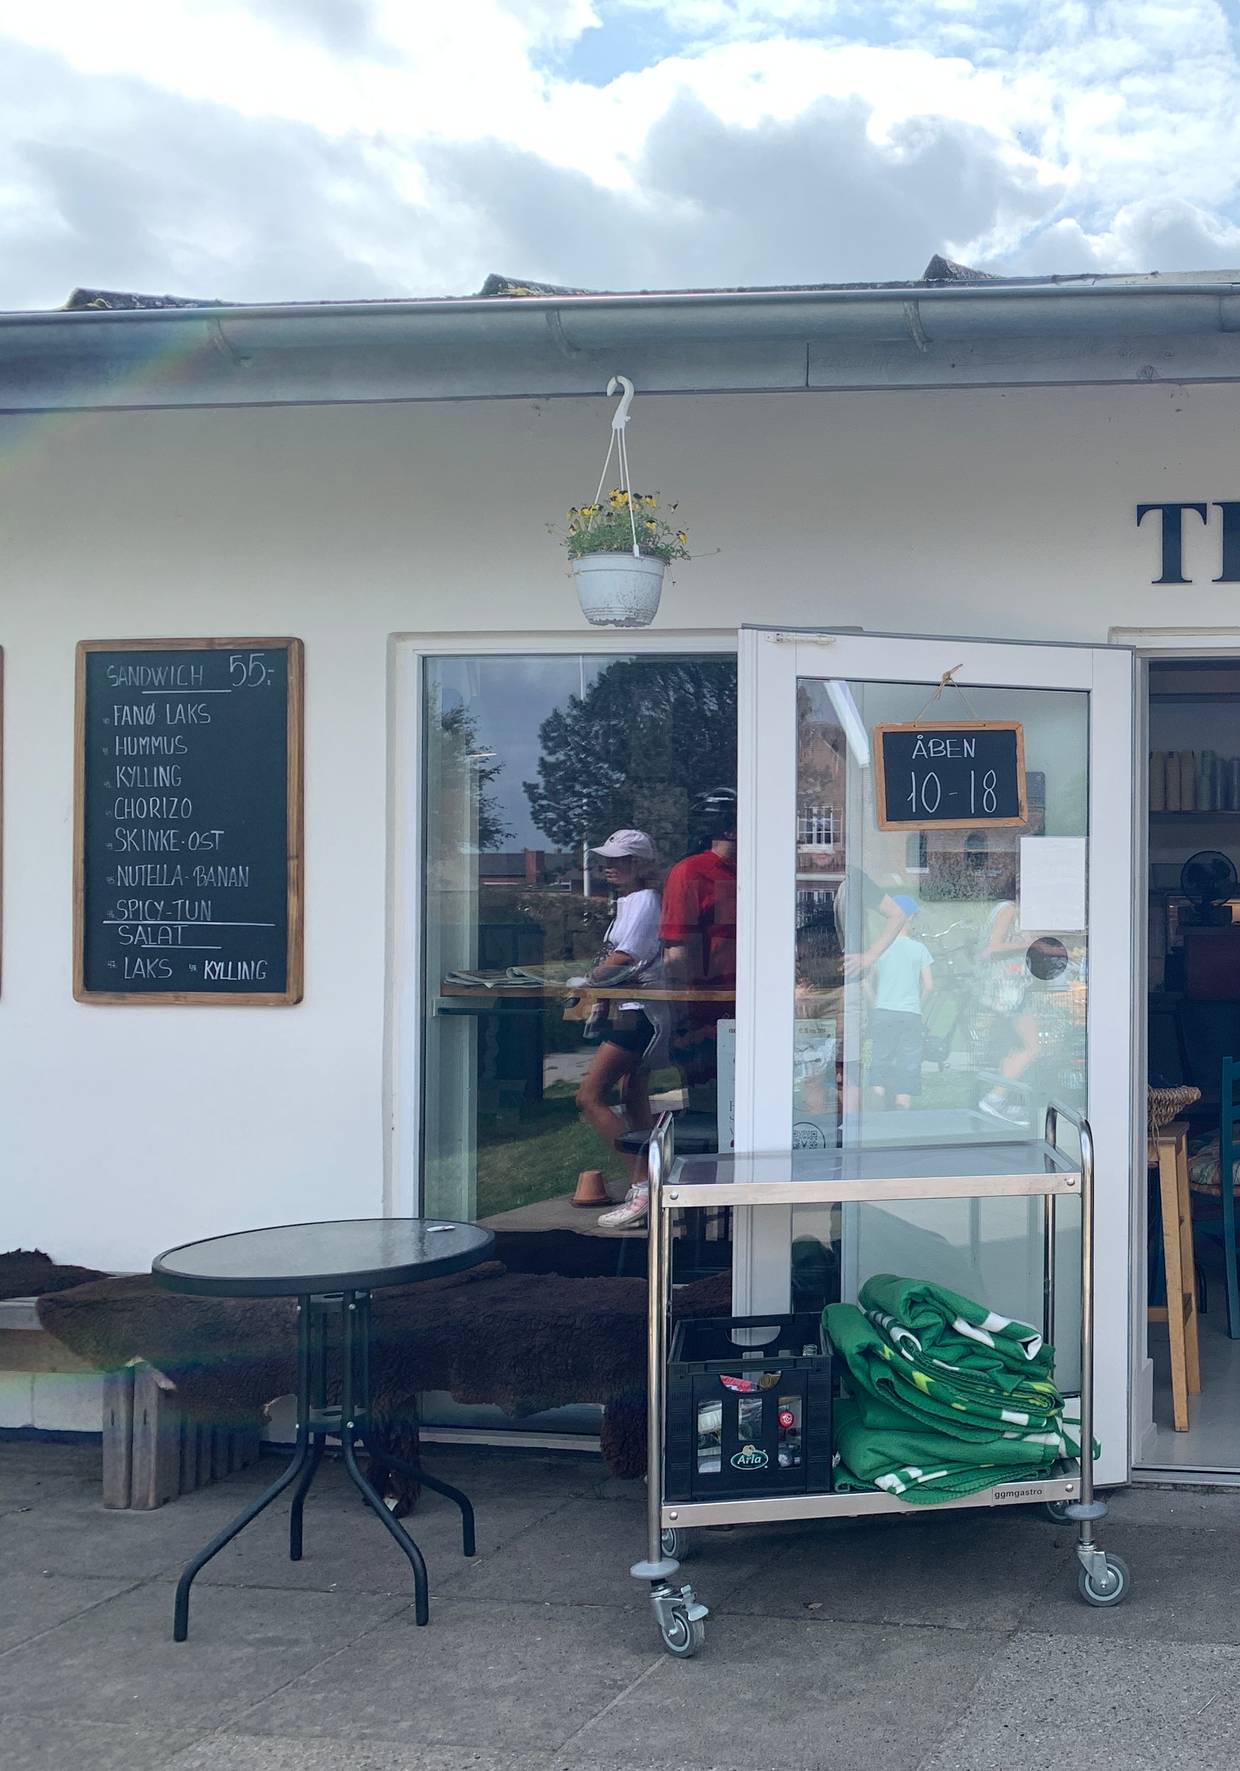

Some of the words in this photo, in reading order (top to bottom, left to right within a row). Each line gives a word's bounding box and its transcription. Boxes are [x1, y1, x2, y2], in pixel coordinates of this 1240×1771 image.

[106, 664, 204, 687] SANDWICH
[114, 702, 156, 726] FANØ
[166, 703, 212, 725] LAKS
[115, 735, 189, 756] HUMMUS
[911, 734, 976, 760] ÅBEN
[115, 765, 183, 789] KYLLING
[114, 796, 193, 820] CHORIZO
[118, 925, 189, 946] SALAT
[124, 957, 173, 979] LAKS
[203, 960, 268, 981] KYLLING
[737, 1453, 762, 1465] Arla
[994, 1488, 1043, 1500] ggmgastro
